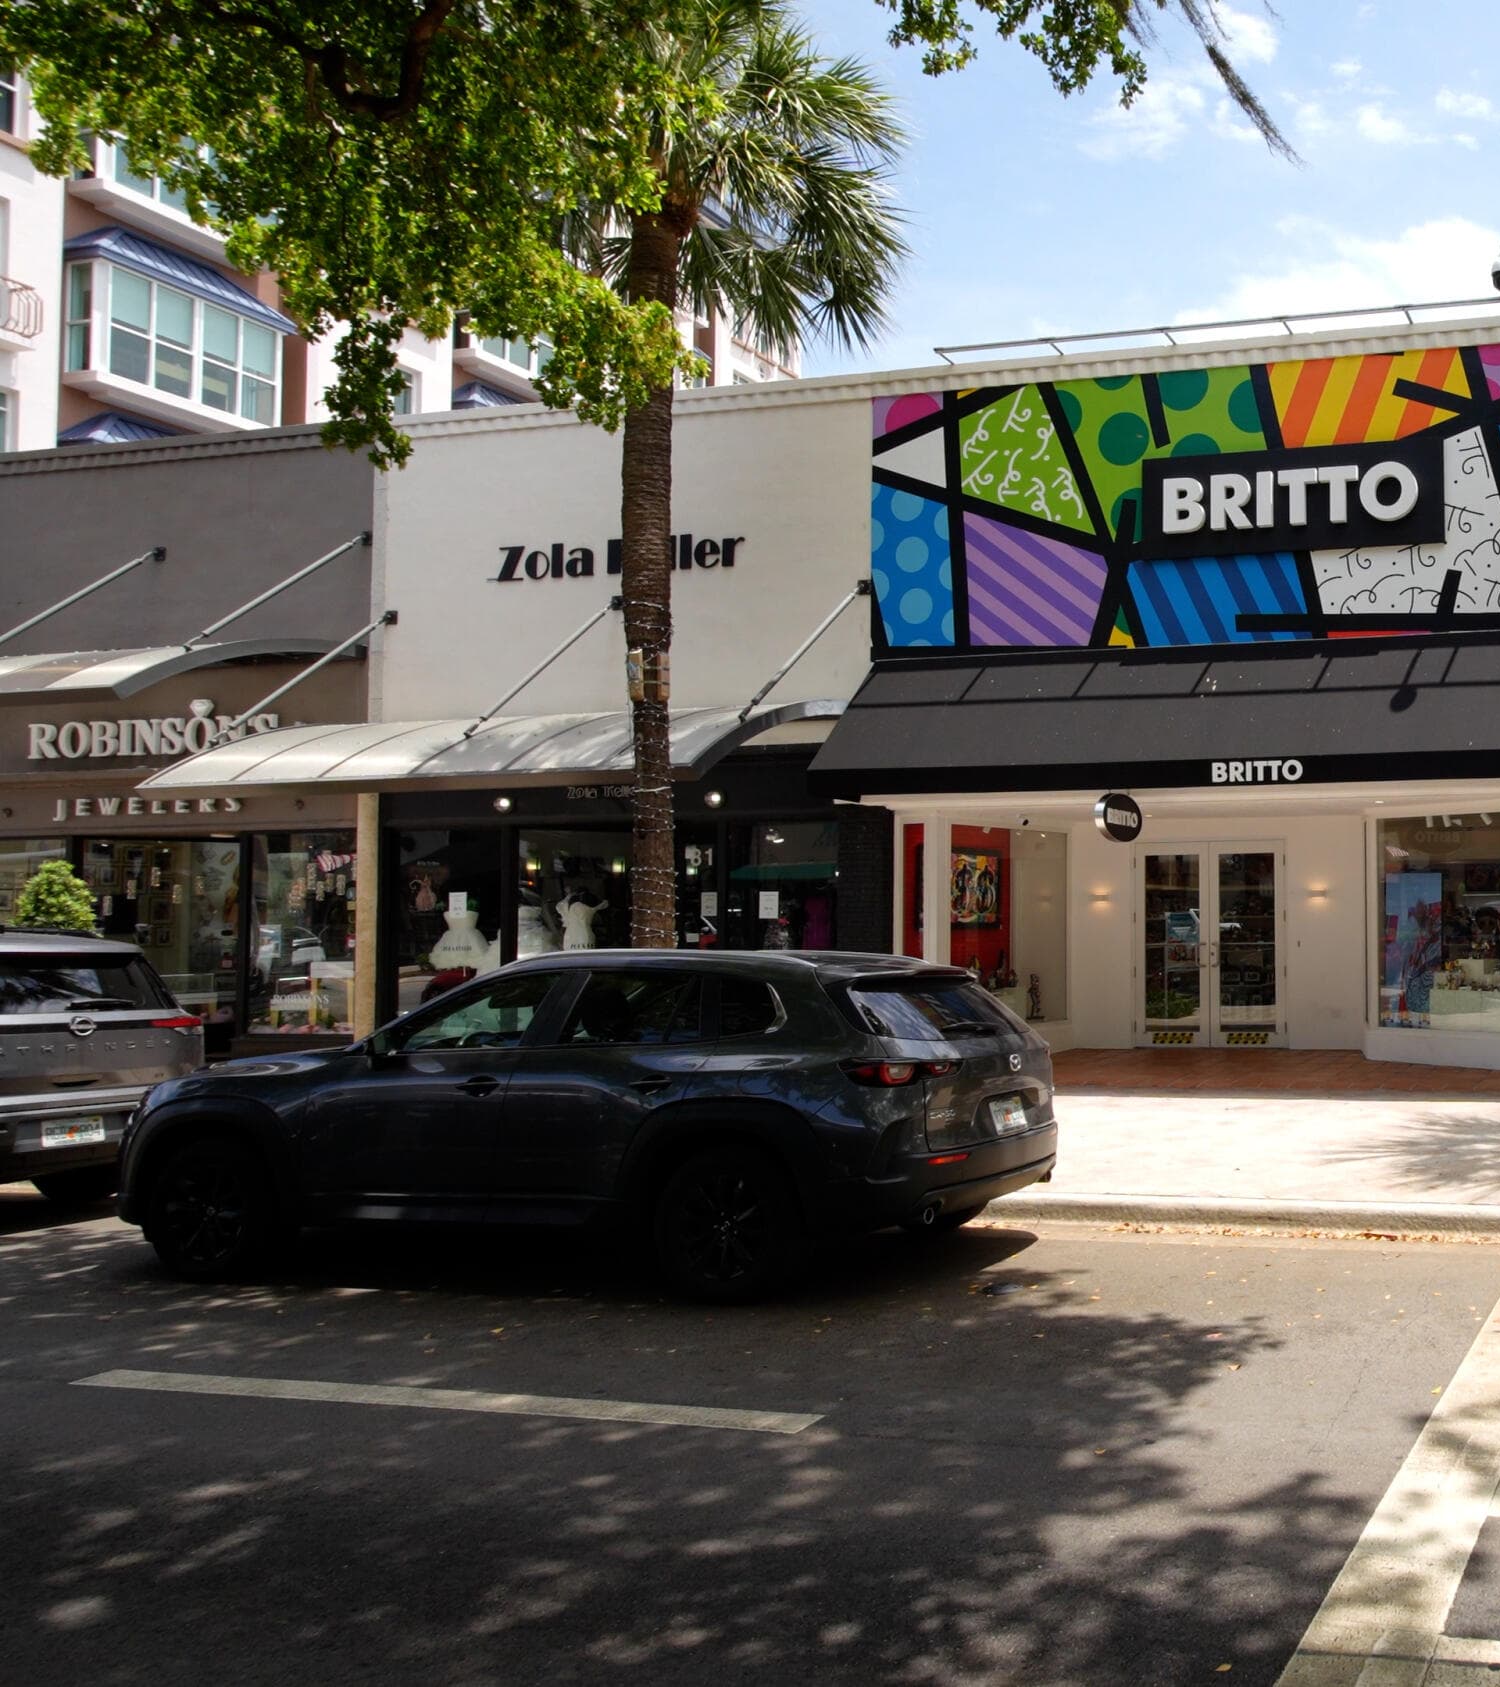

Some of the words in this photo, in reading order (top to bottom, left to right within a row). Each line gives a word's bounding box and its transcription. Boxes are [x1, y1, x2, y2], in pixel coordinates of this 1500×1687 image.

[1162, 461, 1419, 535] BRITTO
[498, 546, 594, 582] Zola
[1211, 759, 1303, 783] BRITTO
[53, 797, 241, 822] JEWELERS
[1107, 808, 1138, 828] BRITTO
